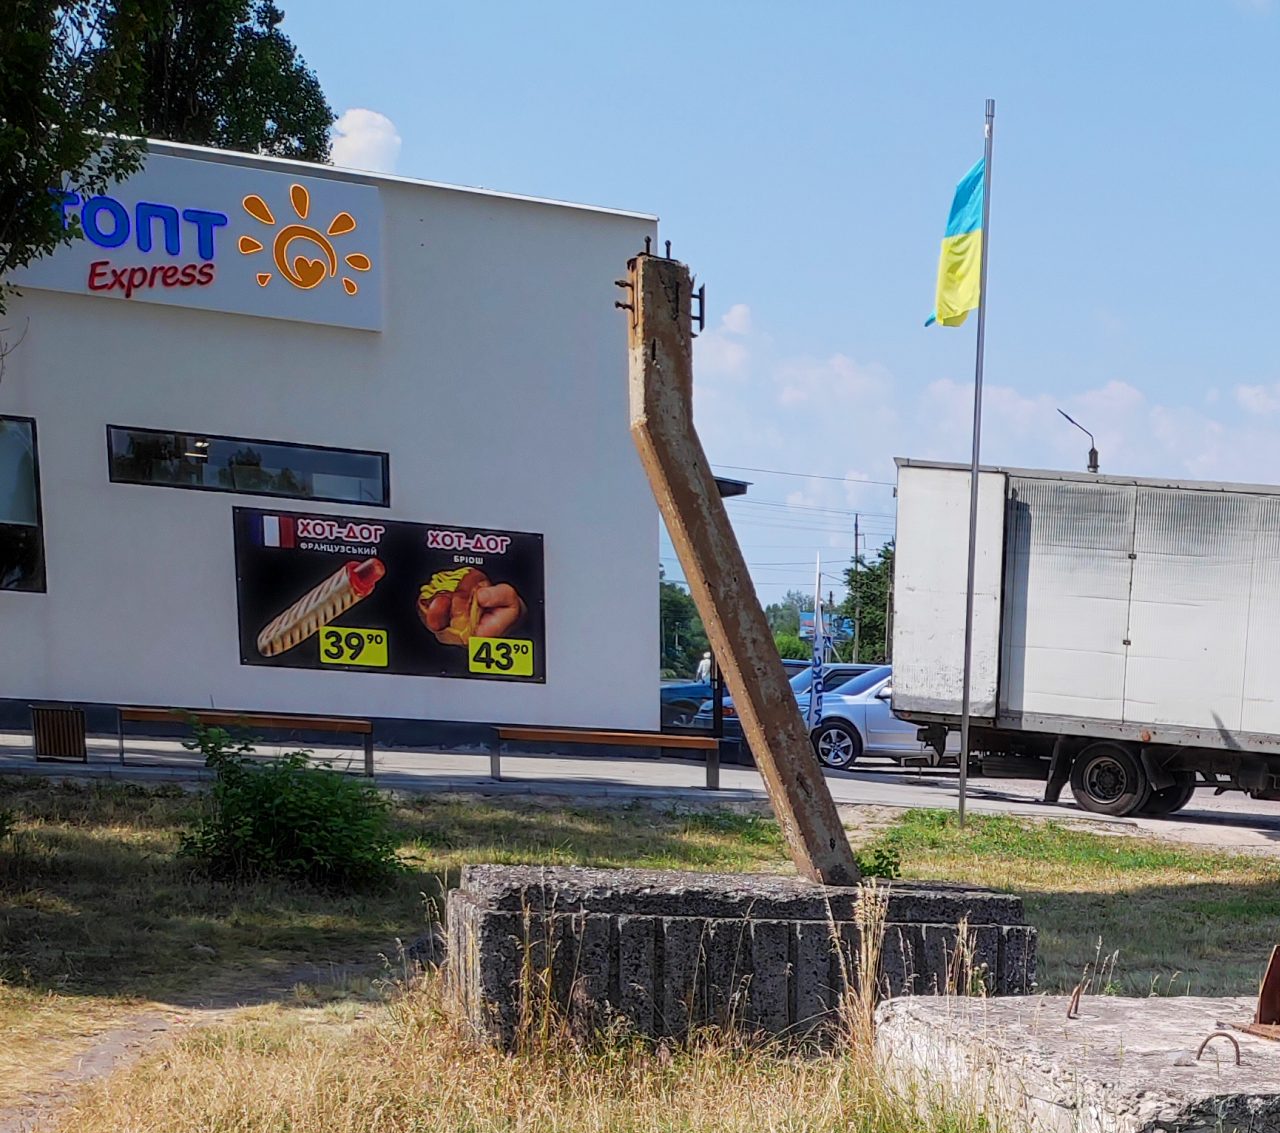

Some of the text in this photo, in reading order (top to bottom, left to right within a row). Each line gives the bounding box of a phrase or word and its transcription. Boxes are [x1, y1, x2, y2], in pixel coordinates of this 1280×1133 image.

[88, 260, 215, 299] Express
[298, 519, 385, 543] ХОТ-ДОГ
[428, 530, 511, 553] ХОТ-ДОГ
[300, 542, 377, 555] ФРАНЦУЗСЬКИЙ
[453, 555, 484, 565] БРІОШ
